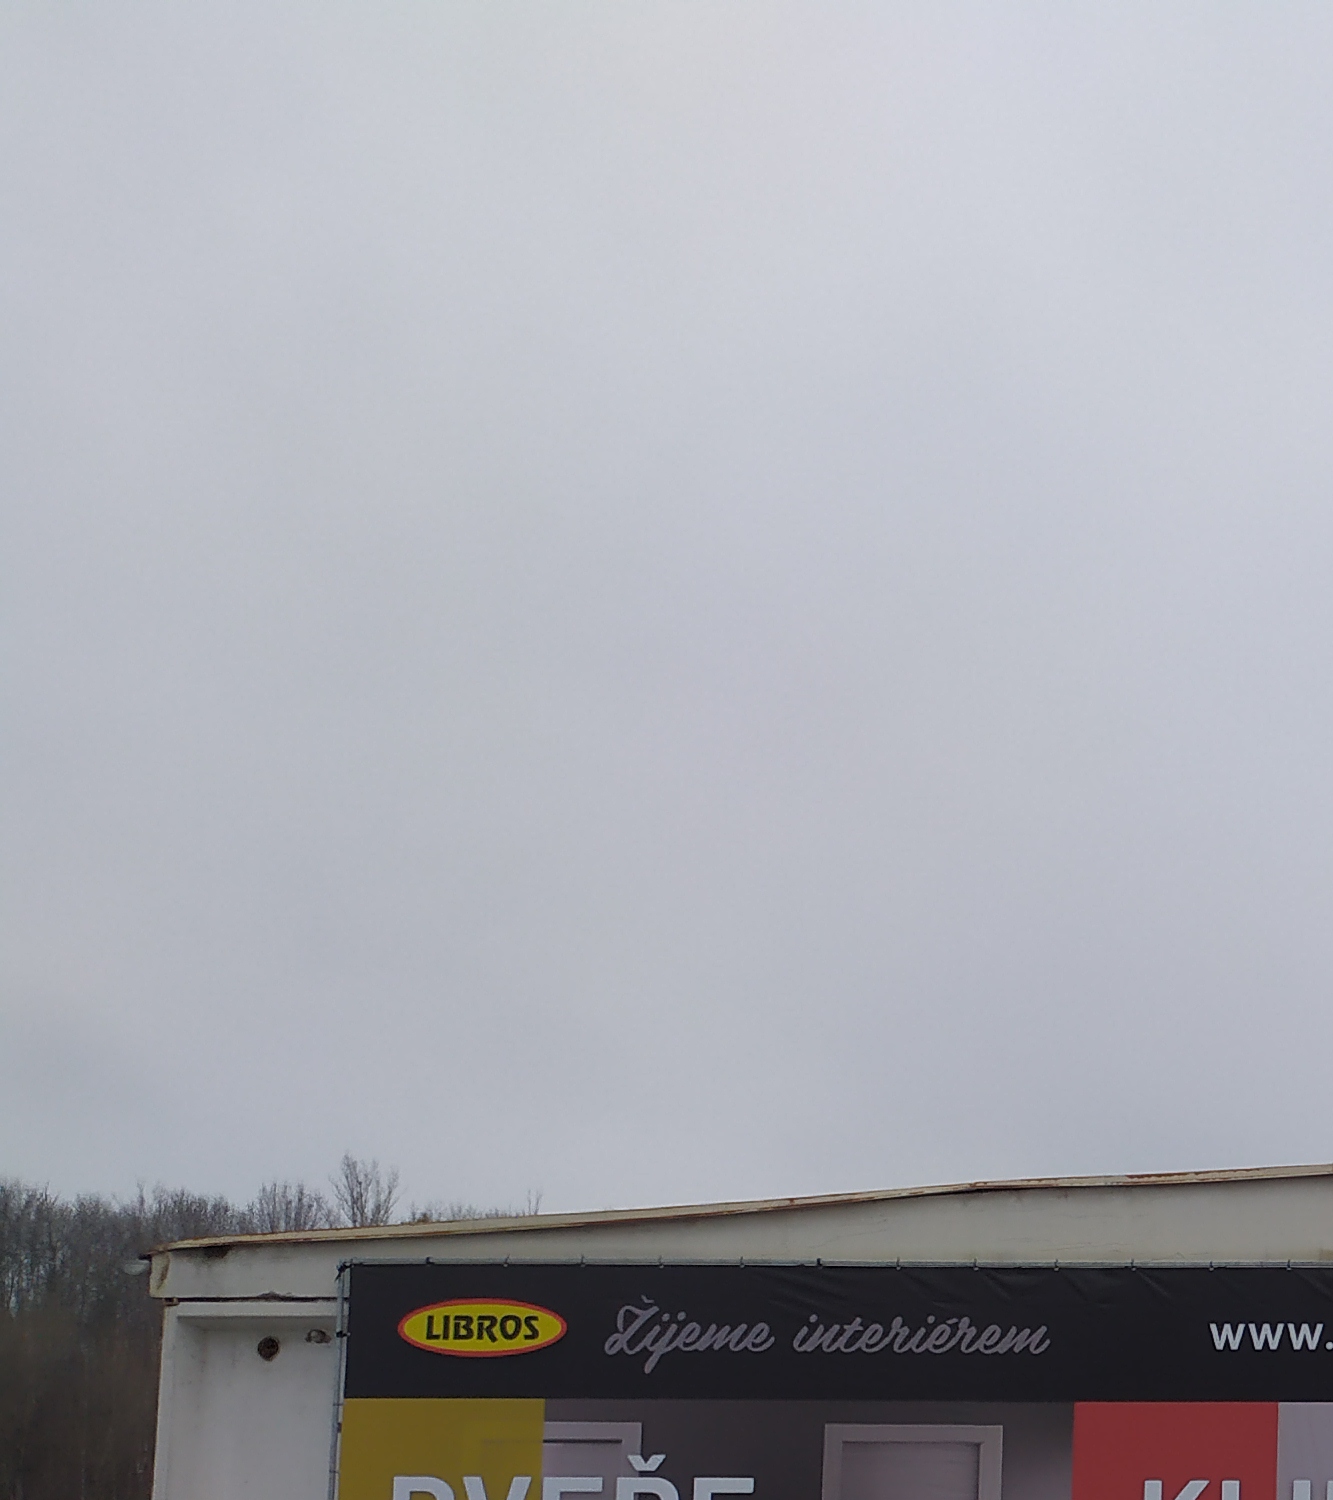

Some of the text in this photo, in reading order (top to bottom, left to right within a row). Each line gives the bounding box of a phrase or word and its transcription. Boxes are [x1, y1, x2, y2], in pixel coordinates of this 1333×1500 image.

[424, 1313, 541, 1344] LIBROS
[604, 1295, 1051, 1374] Žijeme interiérem
